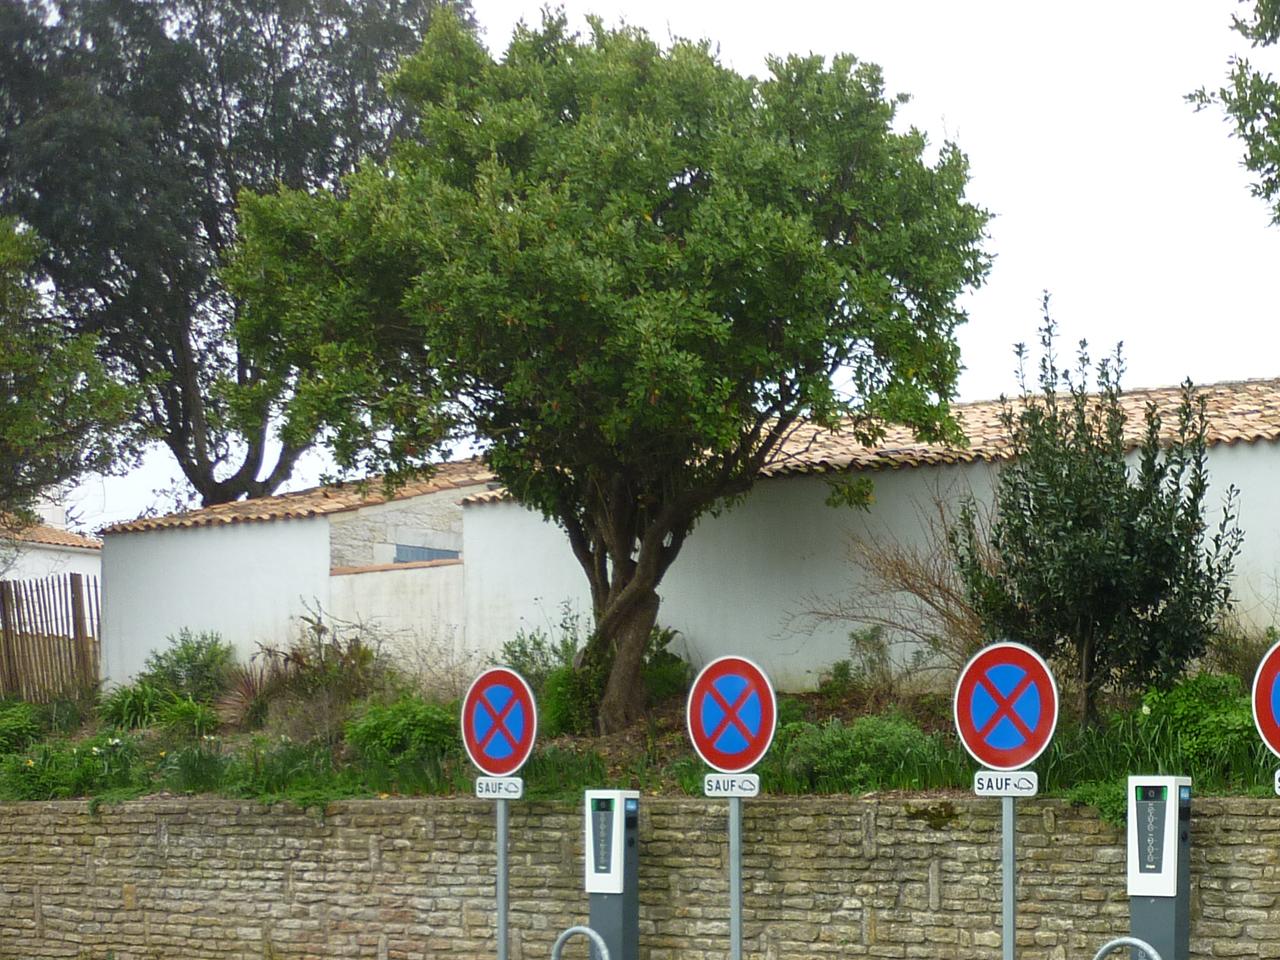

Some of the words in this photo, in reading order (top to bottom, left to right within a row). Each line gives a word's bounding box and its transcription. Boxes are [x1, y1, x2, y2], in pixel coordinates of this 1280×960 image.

[478, 782, 503, 794] SAUF
[707, 779, 737, 792] SAUF
[977, 777, 1011, 791] SAUF
